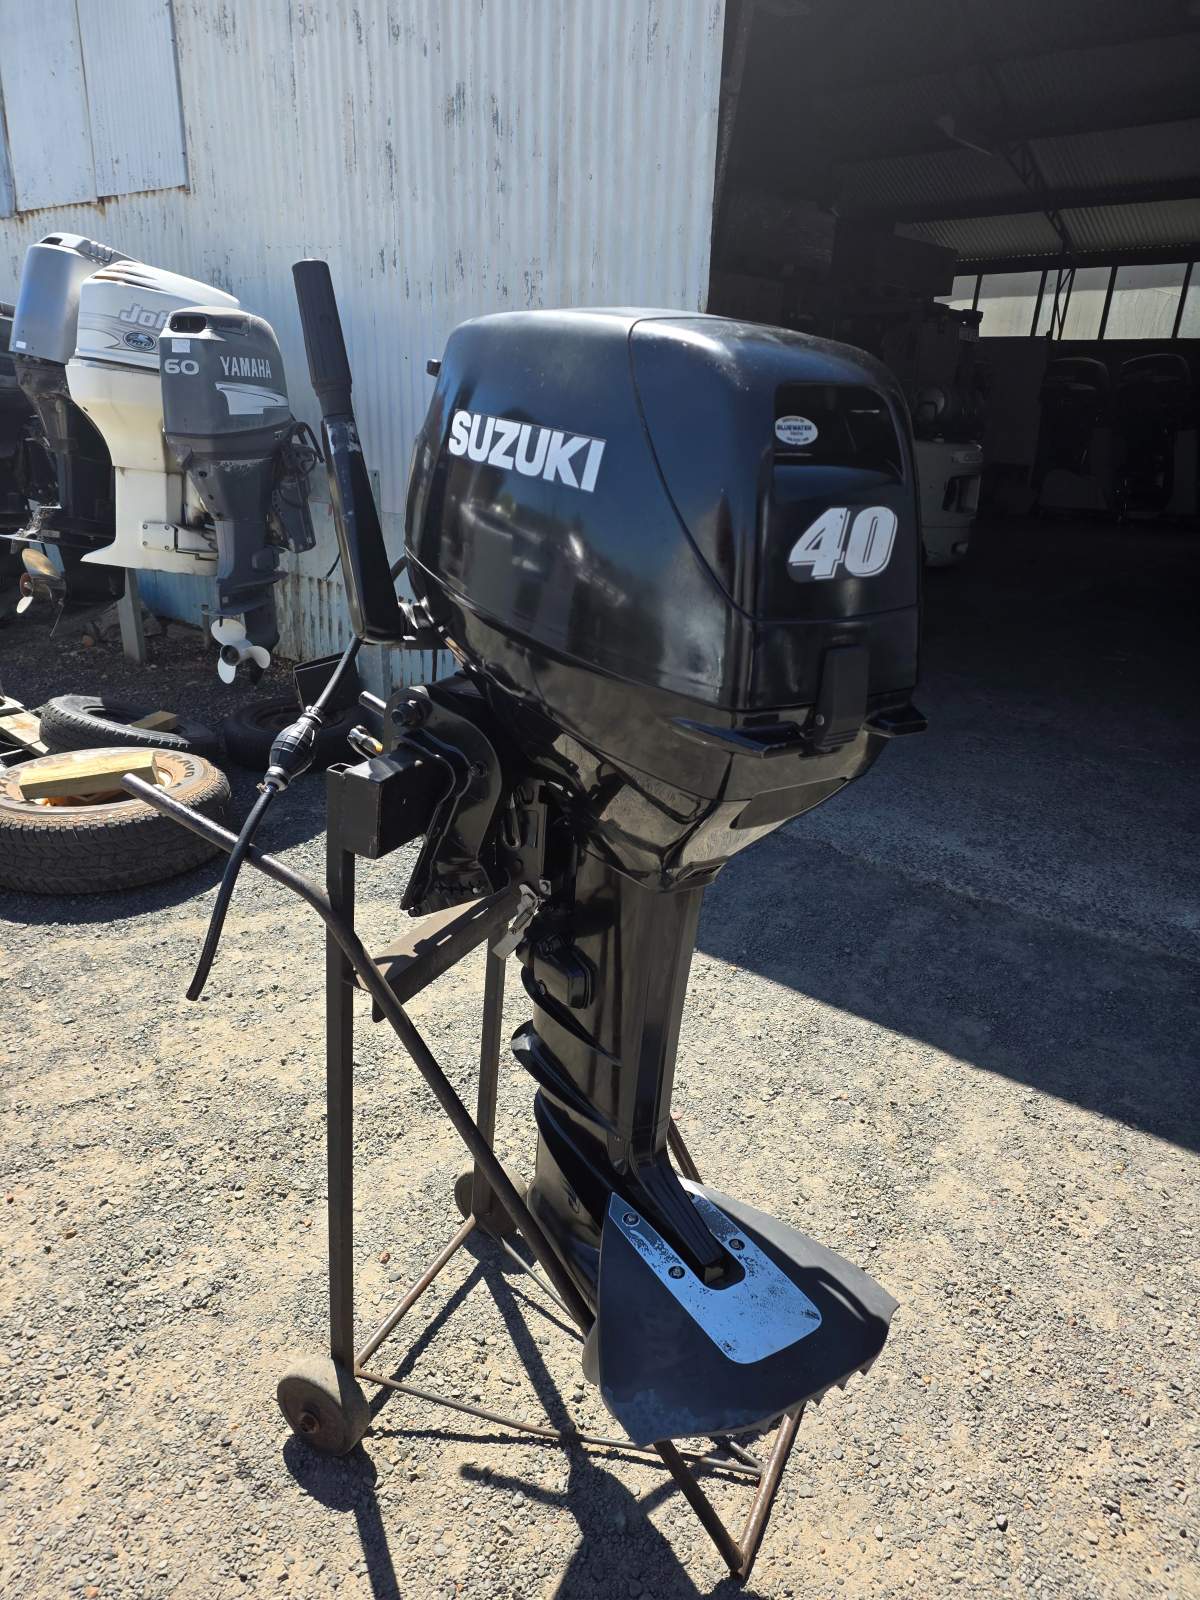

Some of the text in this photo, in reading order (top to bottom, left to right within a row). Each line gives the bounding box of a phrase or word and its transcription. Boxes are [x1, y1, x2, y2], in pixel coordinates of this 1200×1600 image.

[164, 359, 200, 375] 60
[220, 356, 272, 378] YAMAHA
[448, 410, 606, 493] SUZUKI
[788, 506, 898, 580] 40
